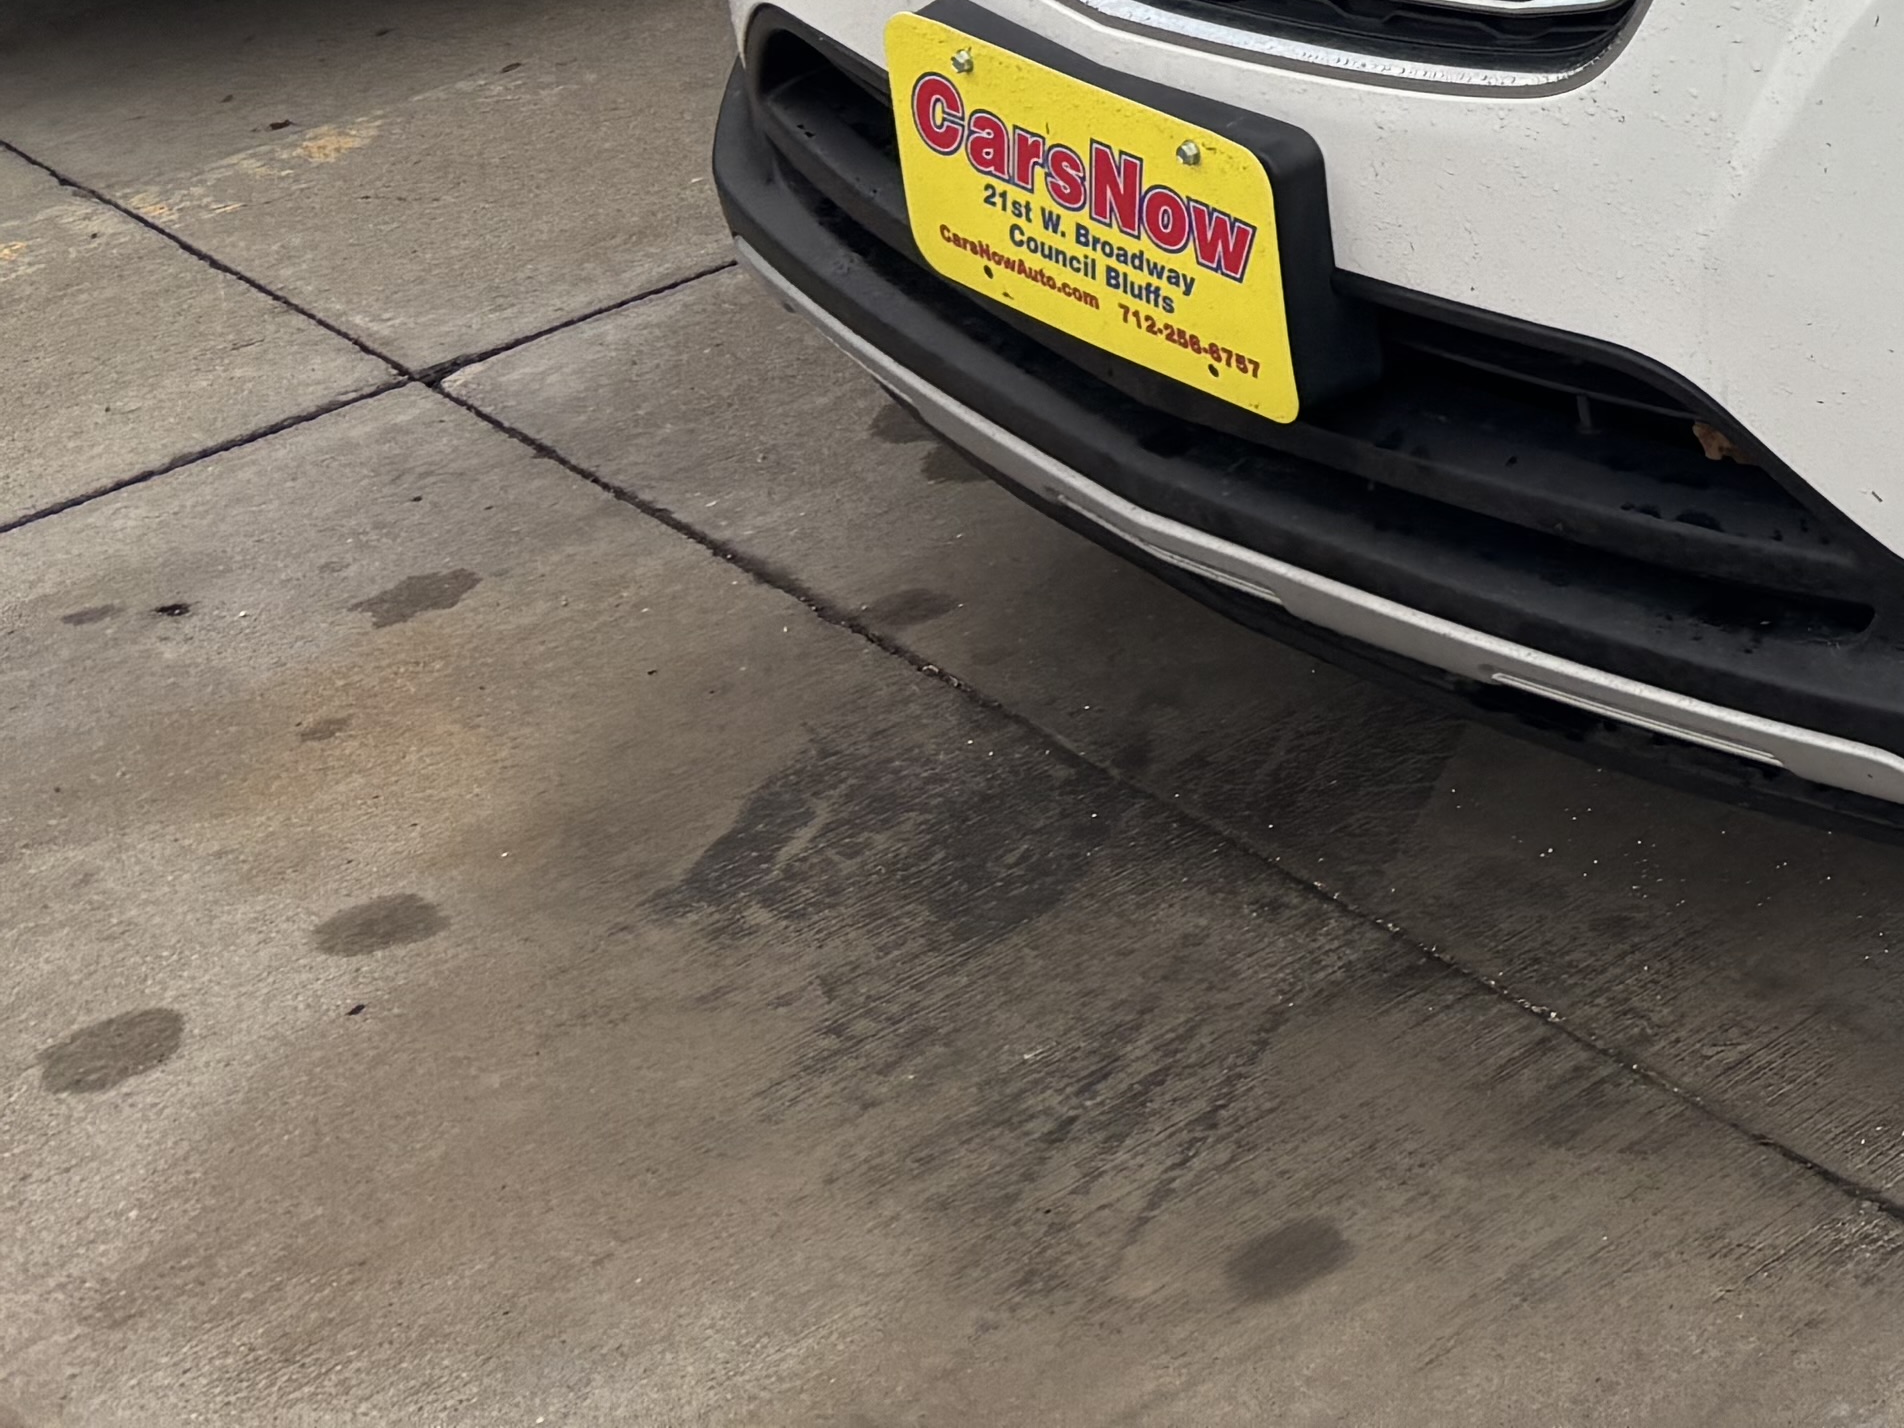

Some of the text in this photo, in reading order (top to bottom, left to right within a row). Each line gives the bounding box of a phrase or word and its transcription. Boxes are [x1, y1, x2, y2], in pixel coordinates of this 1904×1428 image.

[912, 72, 1257, 282] CarsNow
[938, 224, 1100, 311] CarsNowAuto.com
[982, 182, 1197, 297] 21st W. Broadway
[1008, 223, 1175, 315] Council Bluffs
